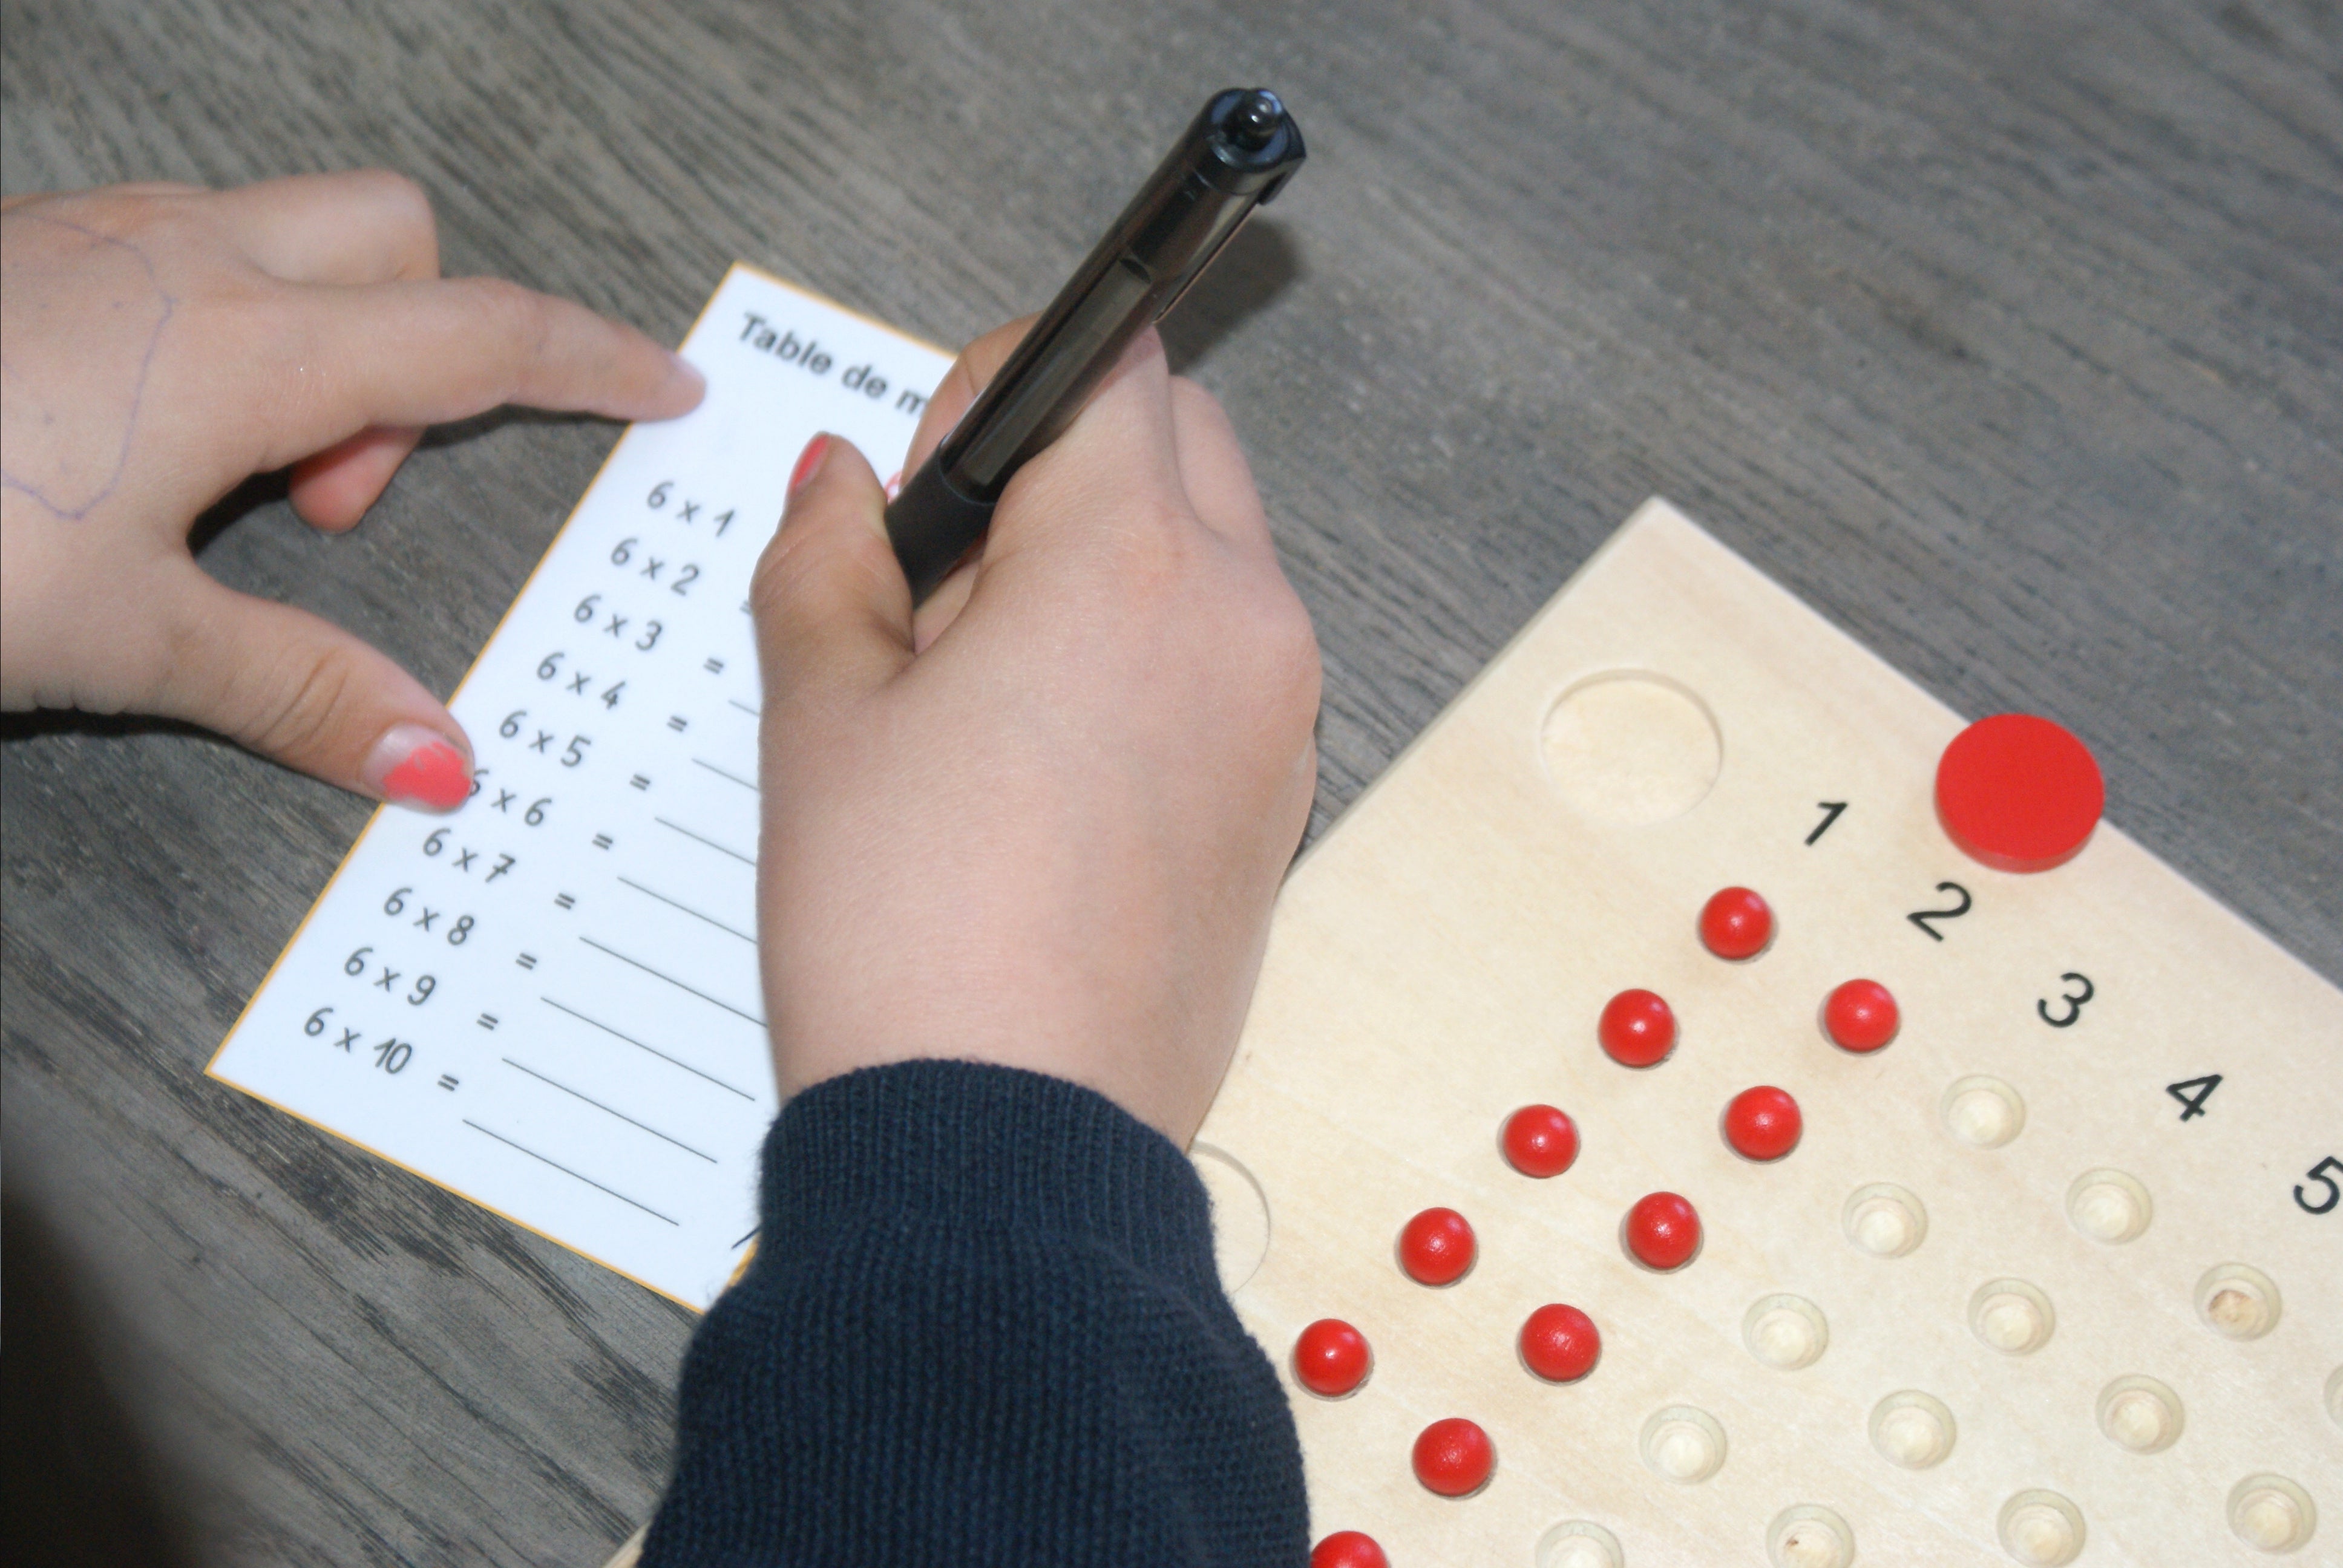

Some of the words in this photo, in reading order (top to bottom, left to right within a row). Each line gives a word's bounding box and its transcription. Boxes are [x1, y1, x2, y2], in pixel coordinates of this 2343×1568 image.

[739, 312, 834, 374] Table
[842, 365, 888, 399] de
[647, 482, 673, 509] 6
[677, 501, 700, 523] x
[714, 509, 735, 537] 1
[611, 538, 637, 566] 6
[640, 557, 664, 580] x
[670, 564, 700, 596] 2
[574, 595, 601, 622] 6
[604, 614, 628, 638] x
[636, 621, 663, 651] 3
[704, 658, 724, 675] =
[537, 652, 565, 681] 6
[566, 671, 591, 696] x
[601, 681, 626, 710] 4
[667, 716, 688, 733] =
[499, 711, 527, 739] 6
[529, 730, 554, 754] x
[560, 735, 591, 768] 5
[630, 774, 650, 791] =
[491, 789, 517, 813] x
[524, 798, 552, 827] 6
[592, 834, 614, 851] =
[423, 828, 451, 857] 6
[453, 848, 478, 872] x
[485, 854, 516, 883] 7
[554, 893, 575, 910] =
[384, 887, 413, 916] 6
[414, 907, 440, 932] x
[447, 915, 475, 946] 8
[516, 953, 537, 970] =
[344, 947, 373, 976] 6
[373, 967, 401, 992] x
[407, 975, 437, 1006] 9
[477, 1013, 499, 1031] =
[1804, 801, 1849, 847] 1
[1906, 881, 1973, 942] 2
[2037, 972, 2095, 1028] 3
[2165, 1073, 2224, 1122] 4
[2293, 1155, 2343, 1215] 5
[304, 1007, 334, 1037] 6
[333, 1027, 362, 1053] x
[373, 1037, 413, 1075] 10
[437, 1074, 459, 1092] =
